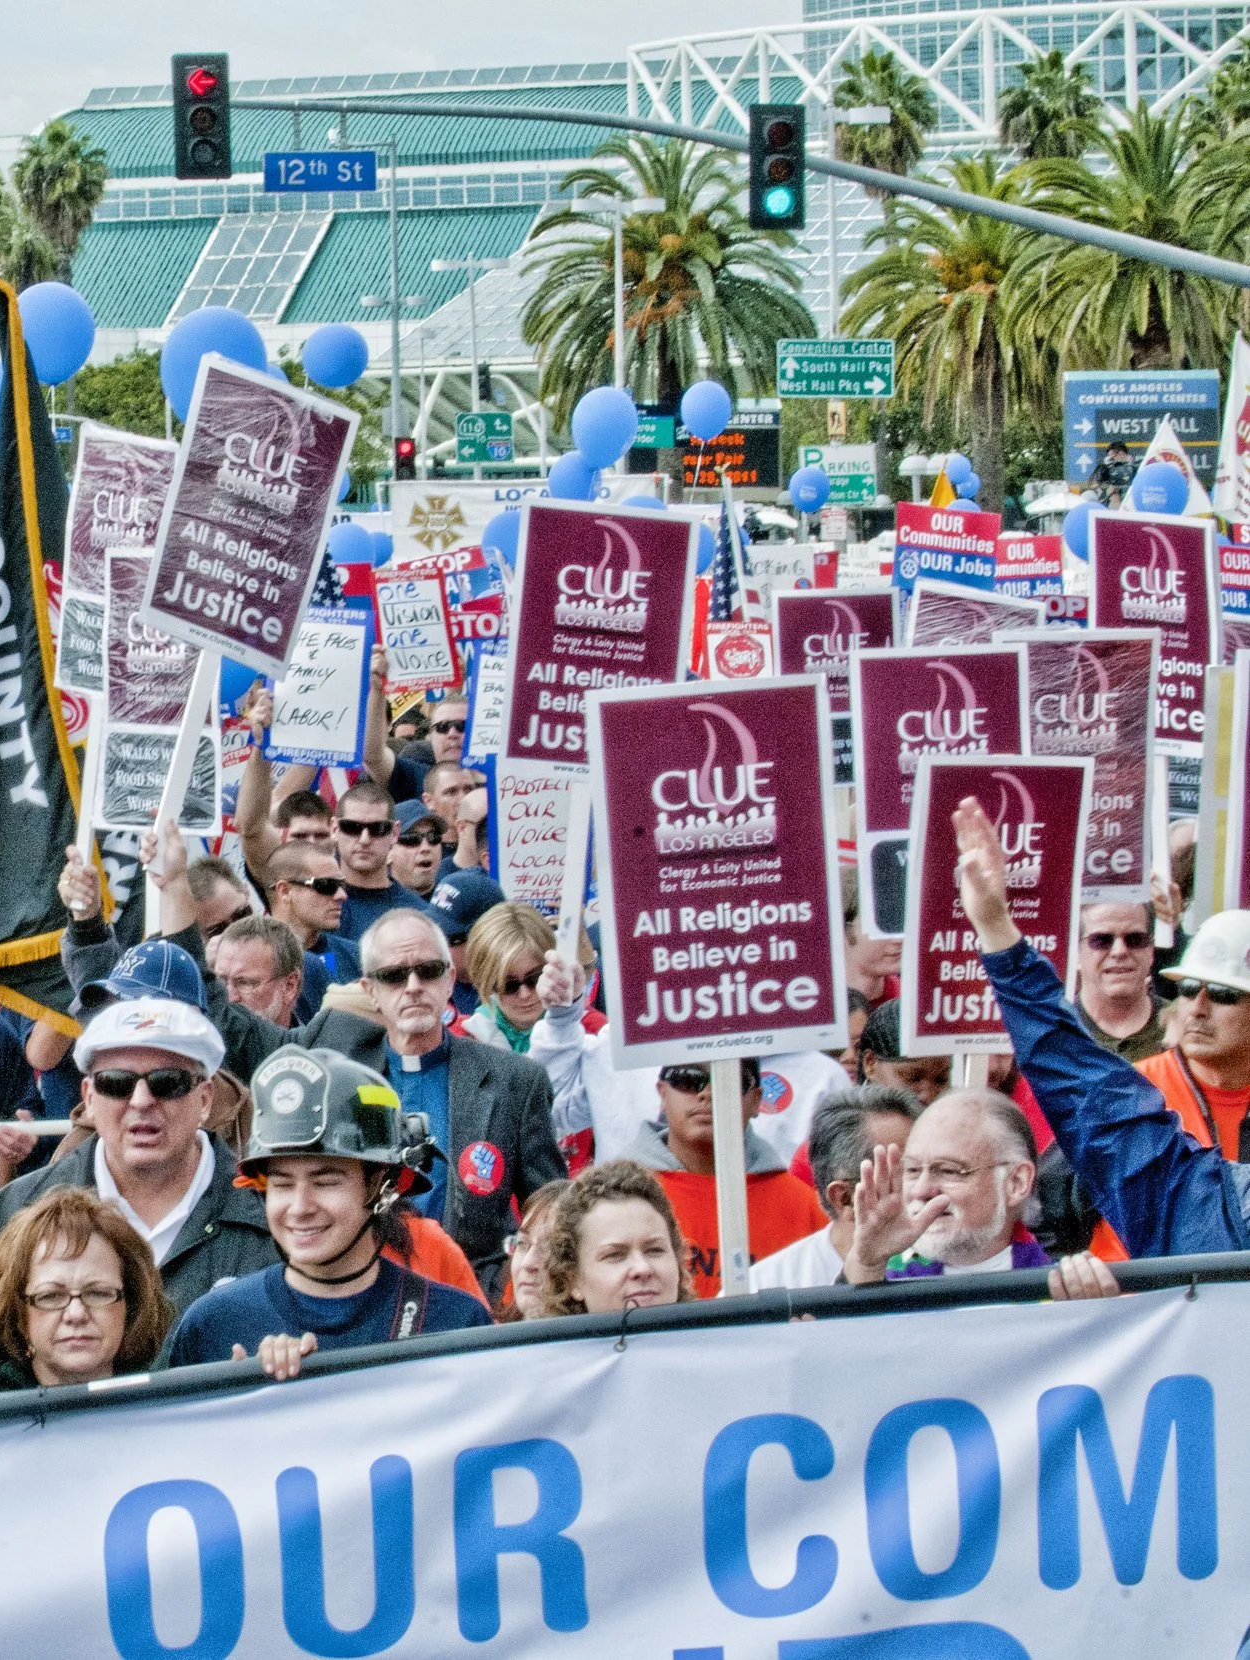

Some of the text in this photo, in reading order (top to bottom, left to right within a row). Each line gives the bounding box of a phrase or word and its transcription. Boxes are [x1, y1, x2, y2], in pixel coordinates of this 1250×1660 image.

[278, 159, 364, 185] 12th St
[780, 342, 892, 355] Convention Center
[802, 361, 891, 376] South Hall Pkg
[780, 379, 861, 394] West Hall Pkg
[1102, 383, 1183, 393] LOS ANGELES
[1079, 393, 1207, 404] CONVENTION CENTER
[462, 422, 482, 433] 110
[727, 413, 774, 425] ENTER
[1102, 419, 1150, 434] WEST
[224, 431, 308, 490] CLUE
[931, 512, 964, 534] OUR
[900, 525, 995, 554] Communities
[180, 520, 299, 582] All Religions
[1007, 542, 1035, 560] OUR
[921, 551, 993, 578] OUR Jobs
[186, 551, 280, 603] Believe in
[558, 564, 652, 602] CLUE
[1120, 565, 1186, 597] CLUE
[1000, 579, 1061, 597] OUR Jobs
[1221, 590, 1248, 607] OUR
[163, 571, 284, 645] Justice
[308, 608, 366, 621] FIGHTERS
[382, 604, 441, 626] Vision
[1124, 607, 1183, 622] LOS ANGELES
[557, 613, 643, 633] LOS ANGELES
[299, 632, 319, 647] HE
[553, 634, 646, 652] Clergy & Laity United
[803, 632, 870, 657] CLUE
[396, 650, 449, 670] Voice
[552, 644, 645, 662] for Economic Justice
[289, 664, 337, 688] FAMILY
[527, 662, 557, 684] All
[1158, 656, 1203, 676] igions
[299, 683, 318, 694] OF
[1180, 682, 1194, 699] in
[538, 690, 587, 714] Belie
[1034, 693, 1119, 731] CLUE
[897, 707, 989, 744] CLUE
[277, 748, 354, 761] FIREFIGHTERS
[651, 762, 775, 812] CLUE
[508, 801, 557, 822] OUR
[1103, 818, 1121, 837] in
[660, 828, 774, 855] LOS ANGELES
[1001, 822, 1046, 857] UE
[659, 856, 782, 882] Clergy & Laity United
[659, 872, 782, 894] for Economic Justice
[1012, 897, 1040, 908] United
[634, 900, 812, 938] All Religions
[929, 931, 957, 952] All
[652, 935, 797, 973] Believe in
[940, 960, 988, 981] Belie
[635, 971, 820, 1027] Justice
[686, 1032, 773, 1052] www.cluela.org
[103, 1374, 1218, 1659] OUR COM
